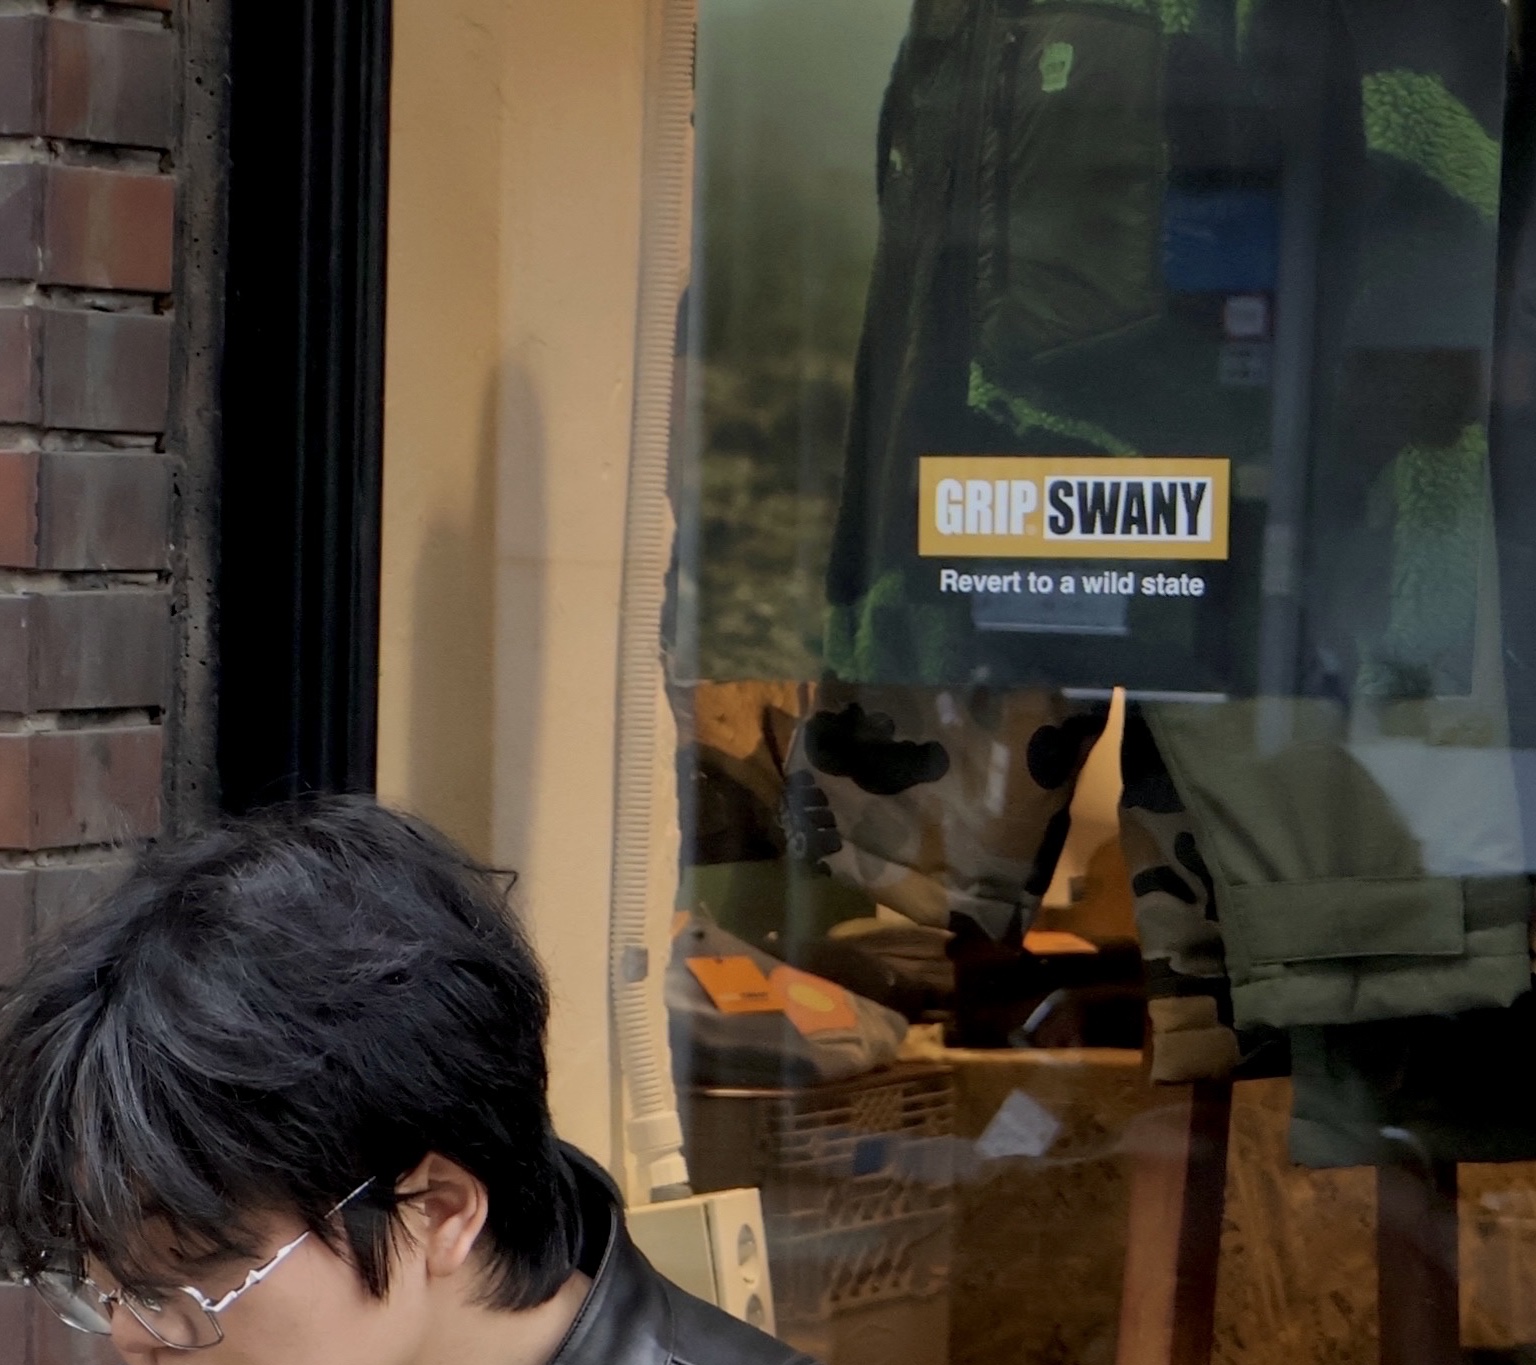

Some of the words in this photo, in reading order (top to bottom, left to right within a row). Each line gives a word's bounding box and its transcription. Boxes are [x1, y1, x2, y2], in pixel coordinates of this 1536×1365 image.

[935, 478, 1038, 536] GRIP
[1048, 480, 1207, 536] SWANY
[939, 568, 1021, 593] Revert
[1027, 571, 1053, 594] to
[1059, 576, 1075, 594] a
[1082, 571, 1135, 595] wild
[1141, 574, 1205, 597] state
